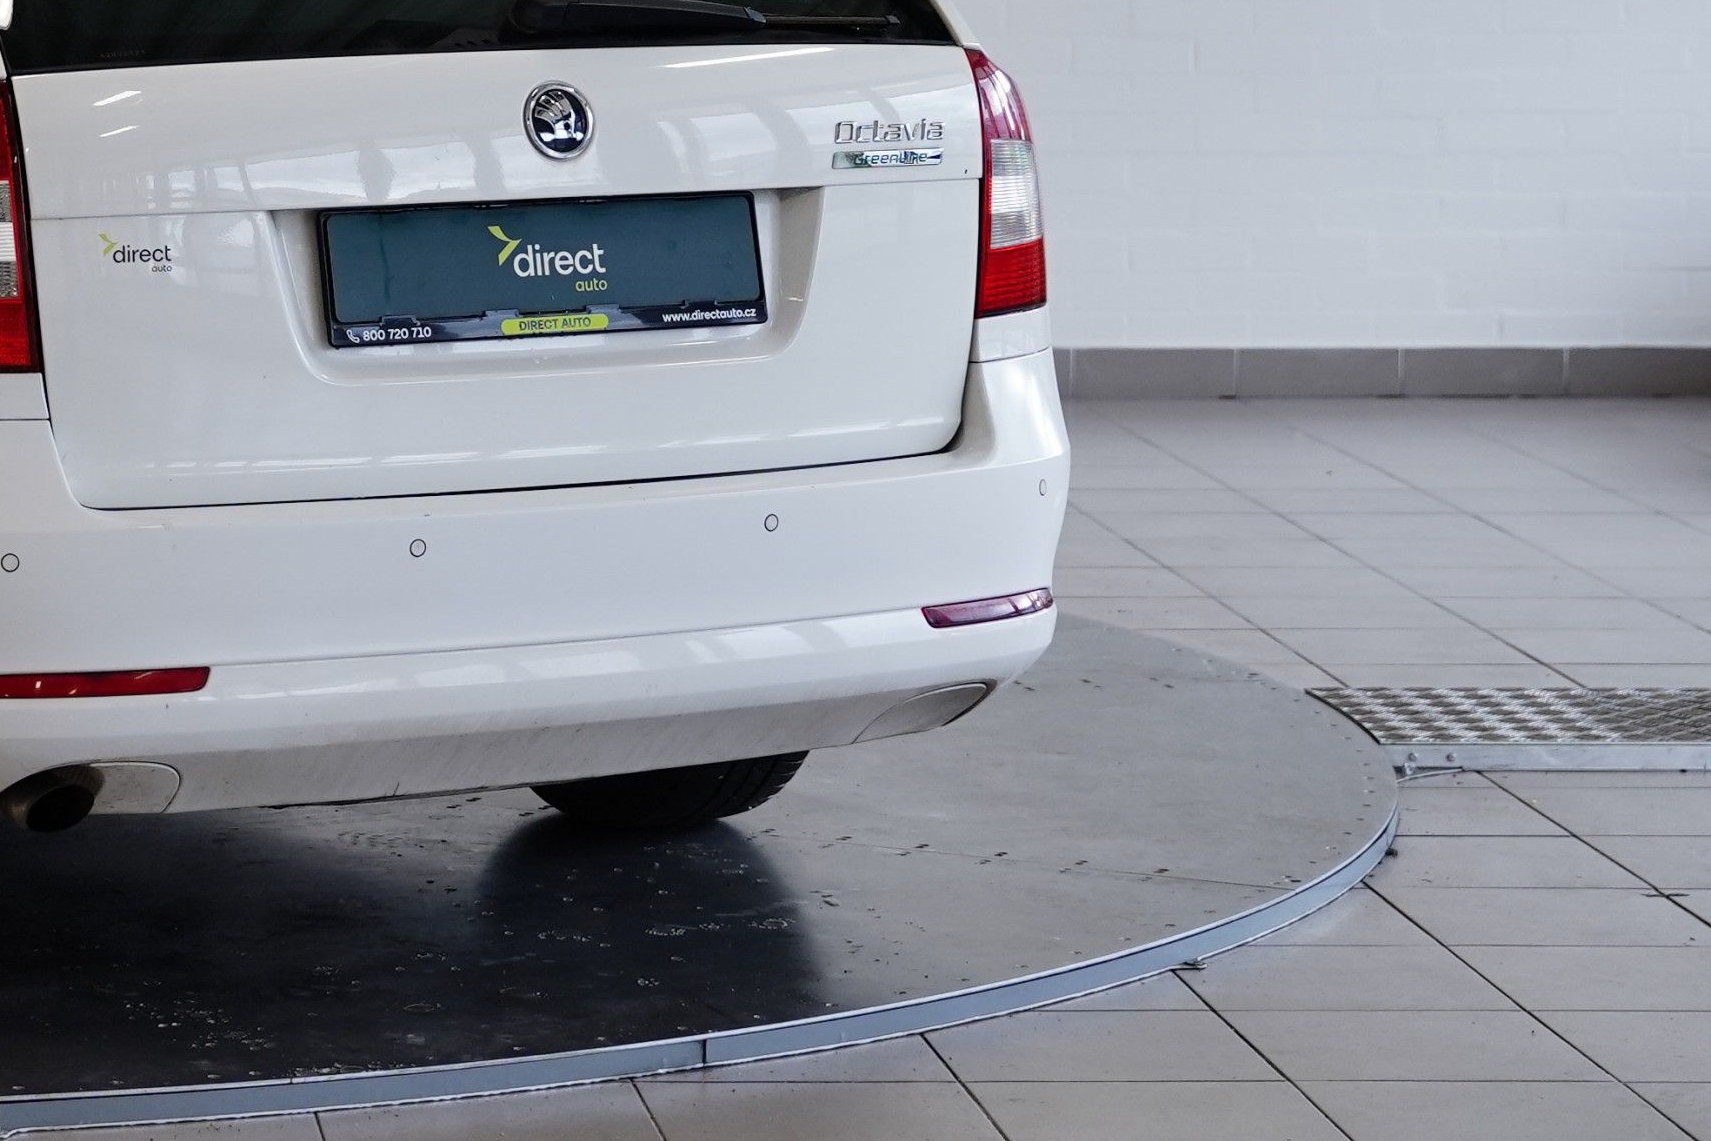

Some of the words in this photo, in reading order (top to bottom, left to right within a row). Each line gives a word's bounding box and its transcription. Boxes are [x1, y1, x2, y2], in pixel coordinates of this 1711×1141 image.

[834, 118, 945, 144] Octavia
[113, 245, 171, 263] direct
[513, 244, 606, 277] direct
[151, 264, 172, 273] auto
[575, 278, 608, 291] auto
[662, 307, 757, 323] www.directauto.cz
[519, 318, 558, 331] DIRECT
[561, 316, 592, 328] AUTO
[362, 329, 386, 341] 800
[388, 327, 409, 340] 720
[412, 326, 432, 338] 710
